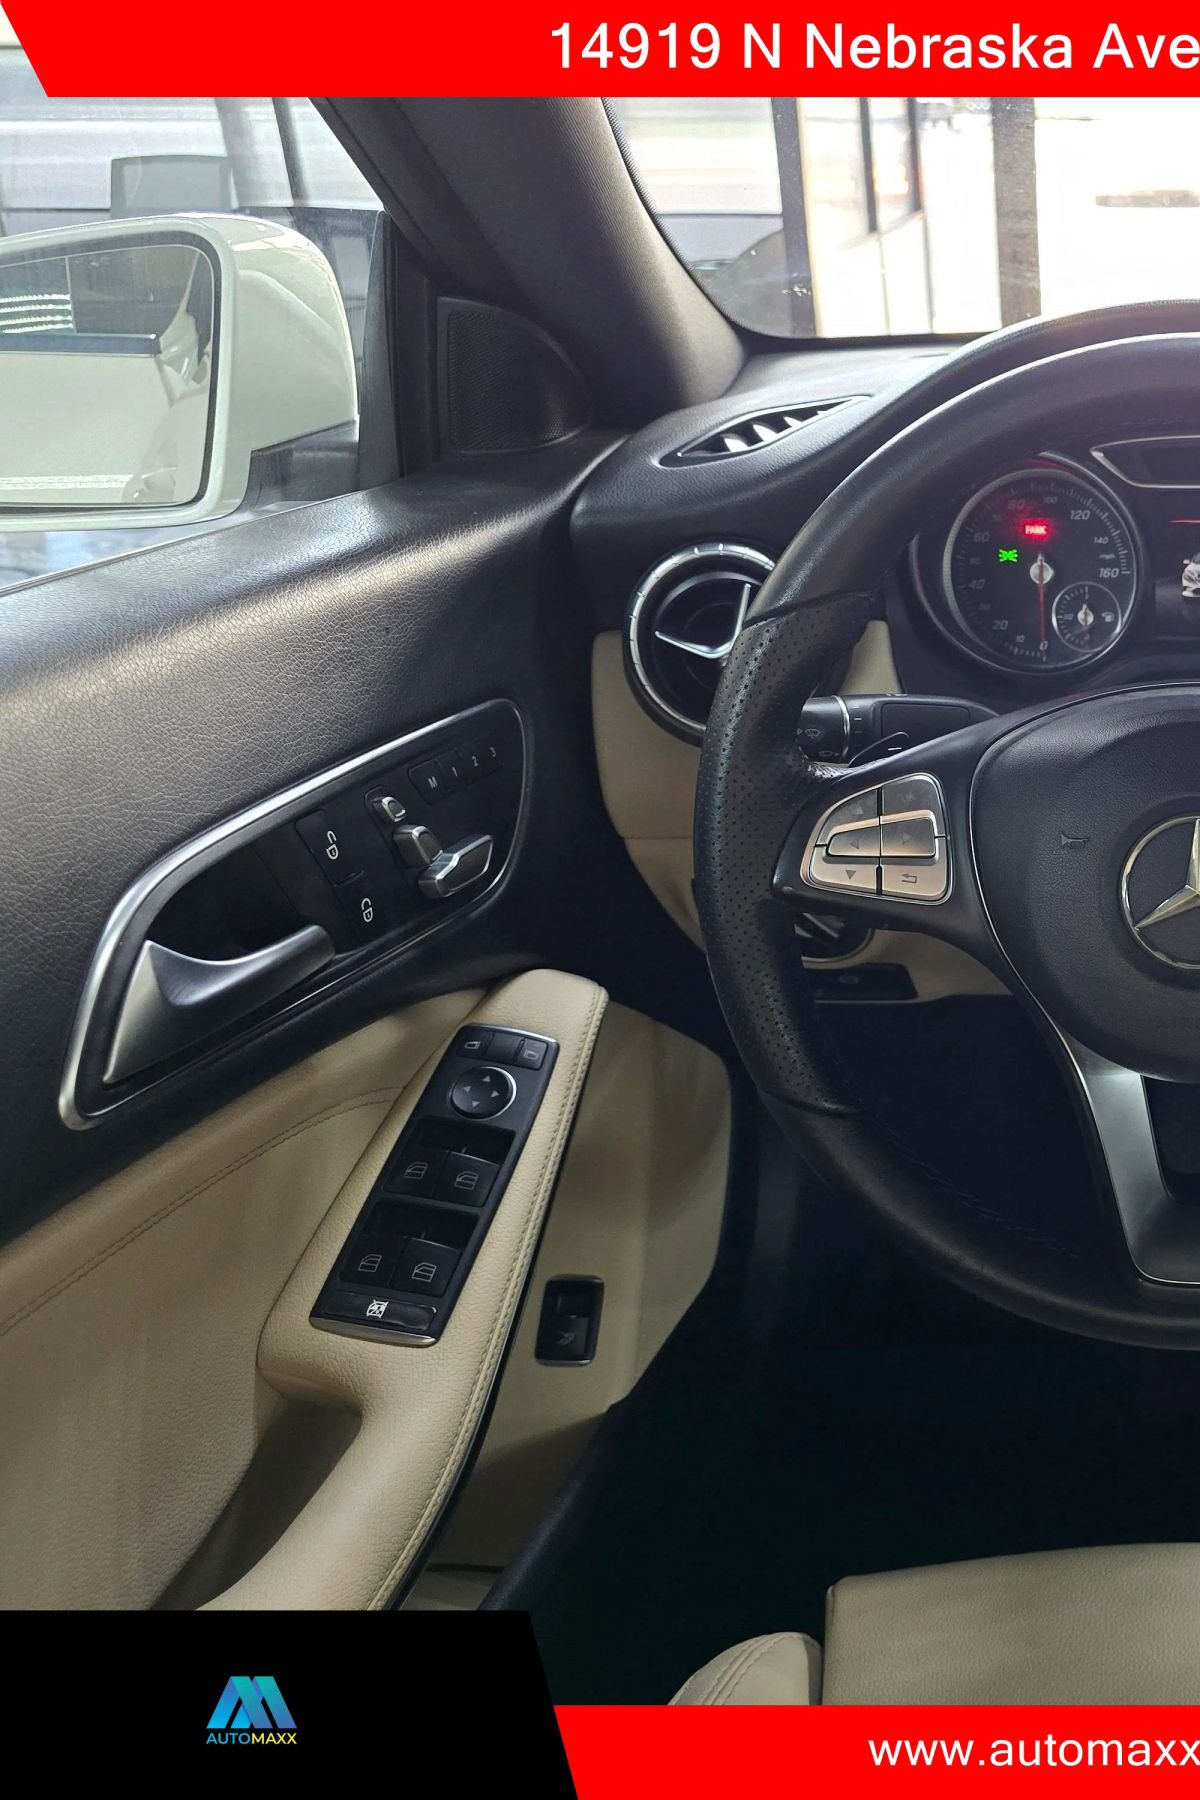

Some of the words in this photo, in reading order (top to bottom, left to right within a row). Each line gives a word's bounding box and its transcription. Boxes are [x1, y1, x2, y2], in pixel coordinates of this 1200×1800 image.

[1070, 509, 1091, 521] 120
[1025, 525, 1048, 535] PARK
[1093, 536, 1109, 545] 140
[1099, 567, 1120, 579] 160
[968, 579, 986, 589] 40
[992, 620, 1009, 631] 20
